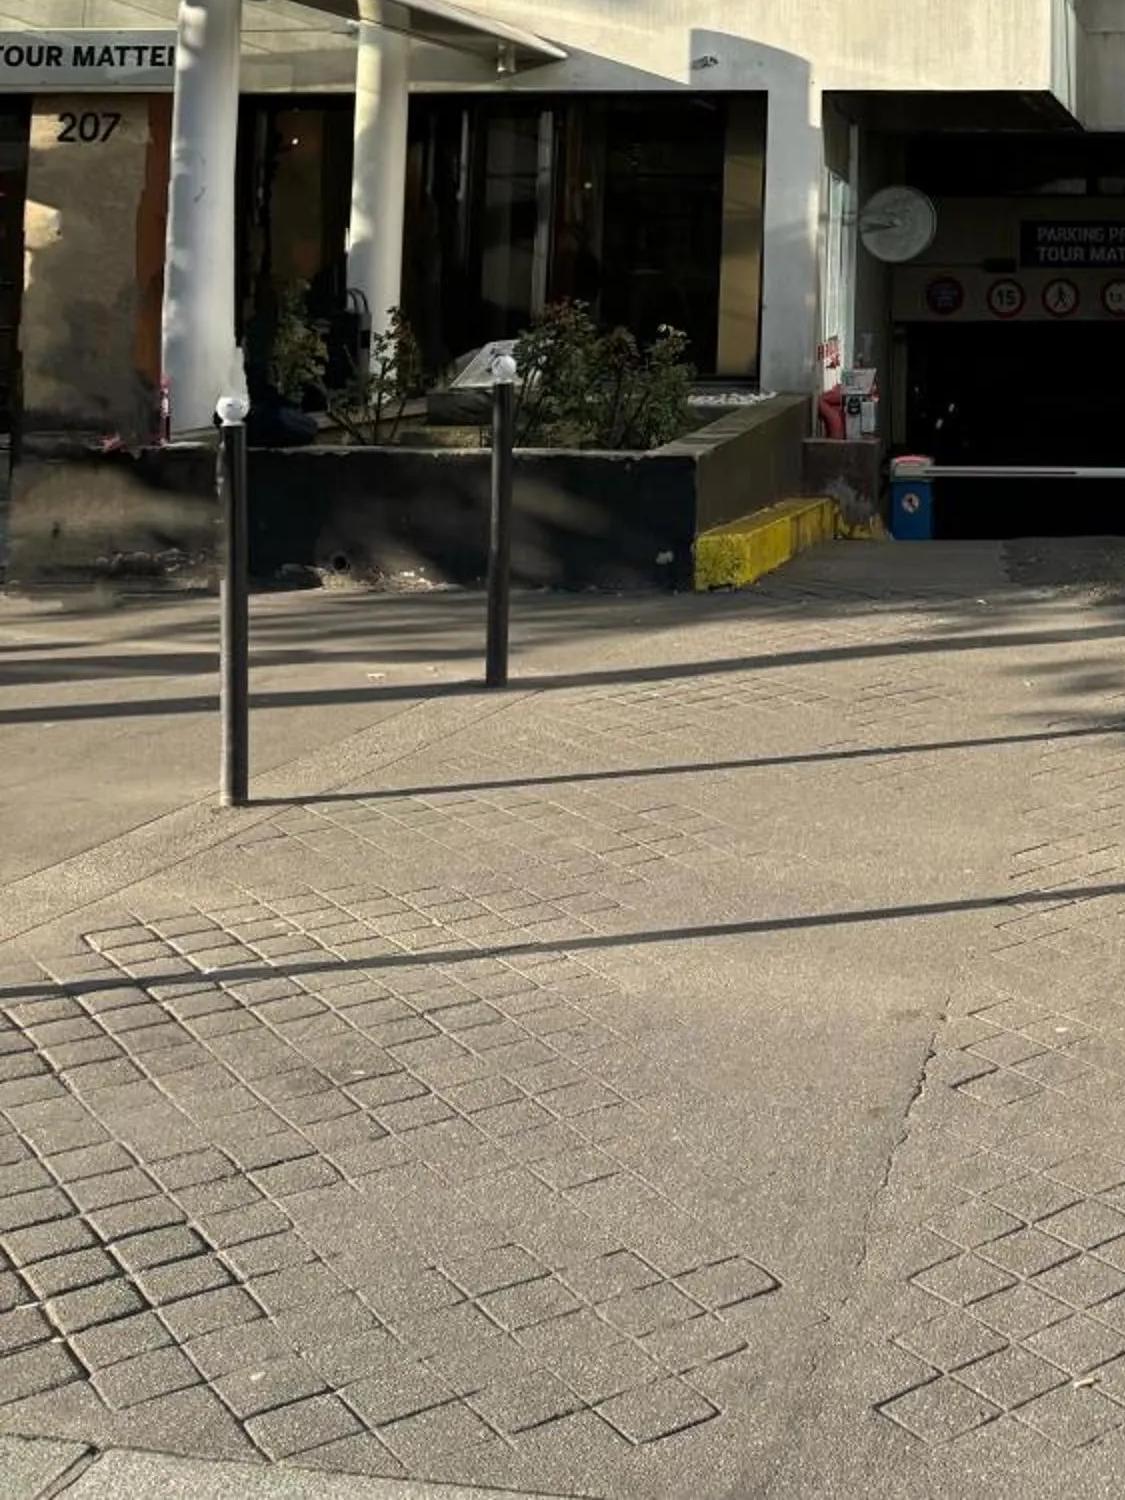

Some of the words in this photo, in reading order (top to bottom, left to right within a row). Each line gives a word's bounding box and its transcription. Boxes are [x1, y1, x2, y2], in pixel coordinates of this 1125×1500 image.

[57, 112, 121, 142] 207
[1037, 227, 1105, 242] PARKING
[1037, 246, 1084, 261] TOUR
[997, 289, 1015, 305] 15
